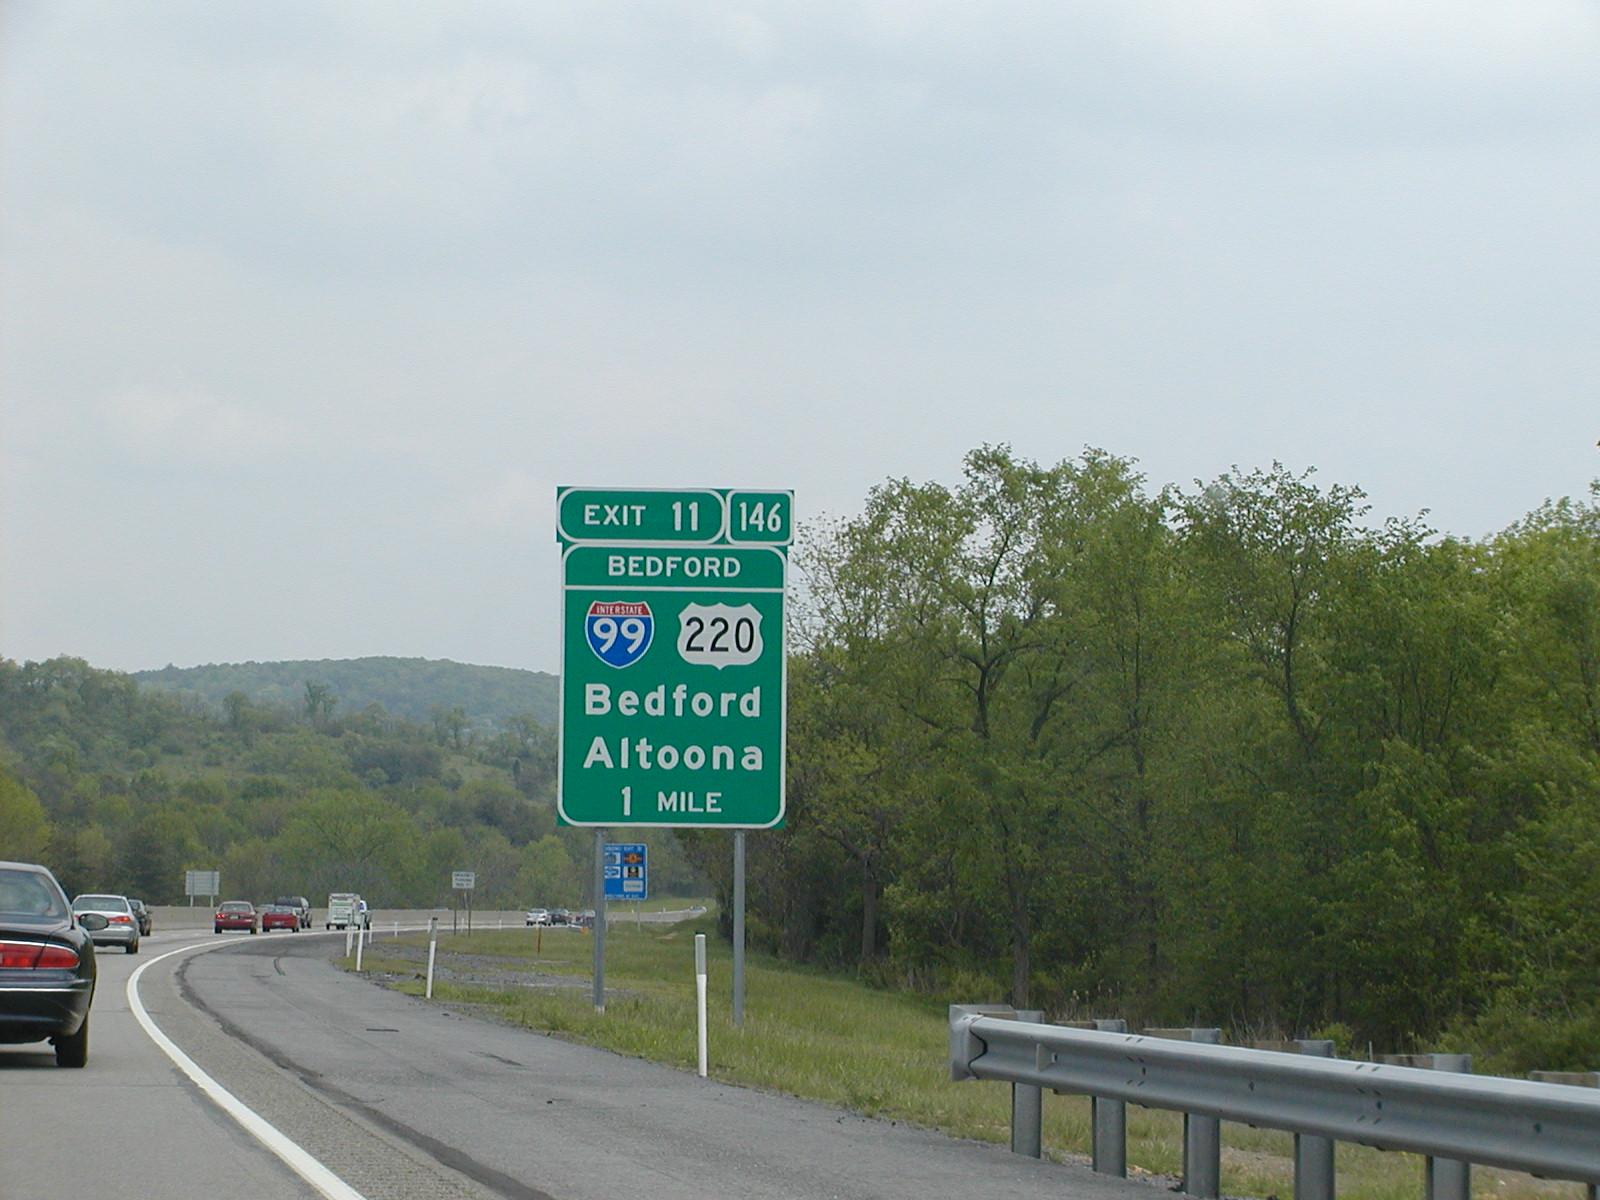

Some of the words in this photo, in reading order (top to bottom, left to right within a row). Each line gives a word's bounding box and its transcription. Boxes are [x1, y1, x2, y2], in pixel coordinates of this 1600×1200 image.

[583, 504, 646, 526] EXIT
[672, 501, 699, 532] 11
[739, 501, 782, 532] 146
[608, 555, 741, 578] BEDFORD
[596, 606, 643, 616] INTERSTATE
[593, 617, 646, 654] 99
[685, 616, 755, 653] 220
[585, 683, 761, 718] Bedford
[583, 736, 763, 771] Altoona
[621, 786, 632, 817] 1
[657, 791, 722, 813] MILE
